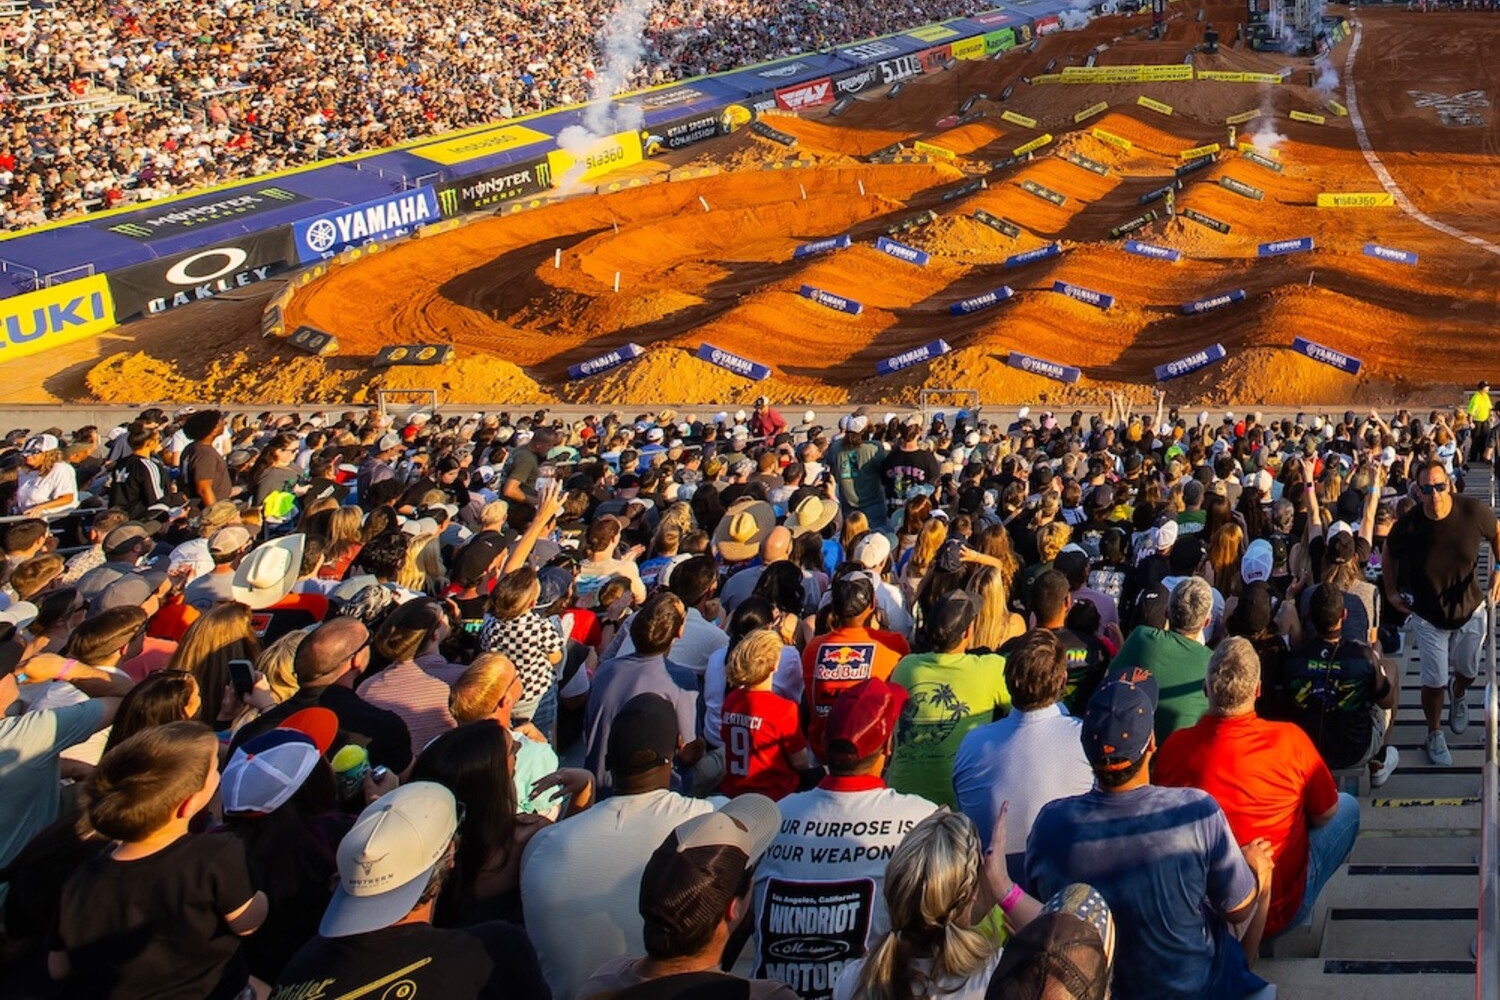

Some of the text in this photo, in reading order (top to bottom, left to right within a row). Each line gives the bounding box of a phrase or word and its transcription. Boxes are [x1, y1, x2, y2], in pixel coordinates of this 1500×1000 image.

[669, 127, 716, 149] COMMISSION
[462, 169, 532, 200] MONSTER
[147, 194, 265, 227] MONSTER
[336, 194, 431, 242] YAMAHA
[148, 265, 272, 314] OAKLEY
[818, 293, 847, 308] YAMAHA
[0, 292, 104, 348] UKI
[720, 351, 754, 373] YAMAHA
[896, 346, 930, 367] YAMAHA
[1315, 344, 1348, 367] YAMAHA
[1030, 358, 1065, 376] YAMAHA
[817, 664, 870, 680] Red Bull
[730, 726, 749, 776] 9
[782, 819, 914, 838] UR PURPOSE IS
[766, 844, 897, 864] YOUR WEAPON
[783, 895, 817, 904] Angeles,
[818, 892, 861, 904] California
[769, 901, 861, 935] WKNDRIOT
[274, 977, 337, 1000] Miller
